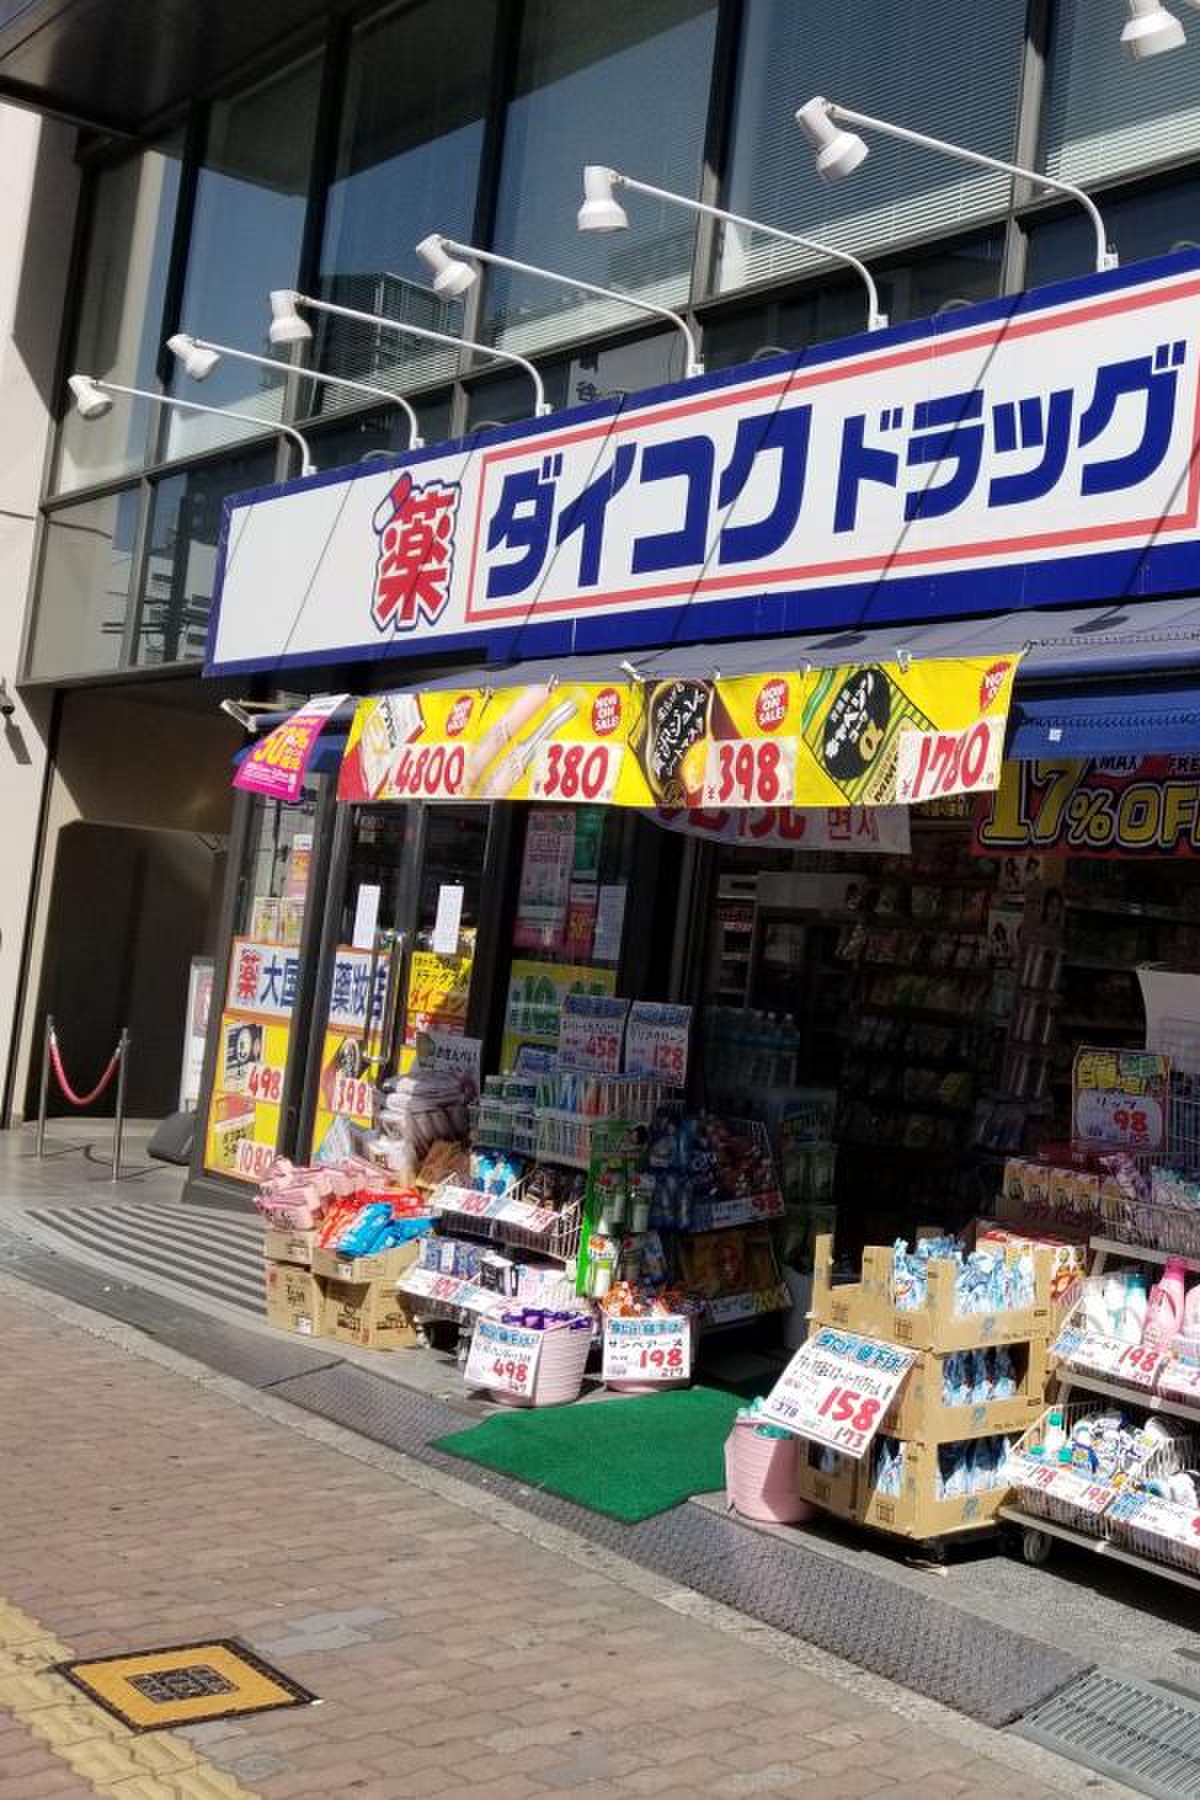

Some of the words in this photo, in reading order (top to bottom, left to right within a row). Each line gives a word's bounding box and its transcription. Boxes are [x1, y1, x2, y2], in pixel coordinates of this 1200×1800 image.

[375, 475, 459, 630] 薬
[248, 1066, 282, 1101] 498
[1112, 1108, 1148, 1133] 98
[493, 1358, 529, 1382] 498
[639, 1348, 683, 1369] 198
[1119, 1346, 1159, 1371] 198
[817, 1386, 881, 1431] 158
